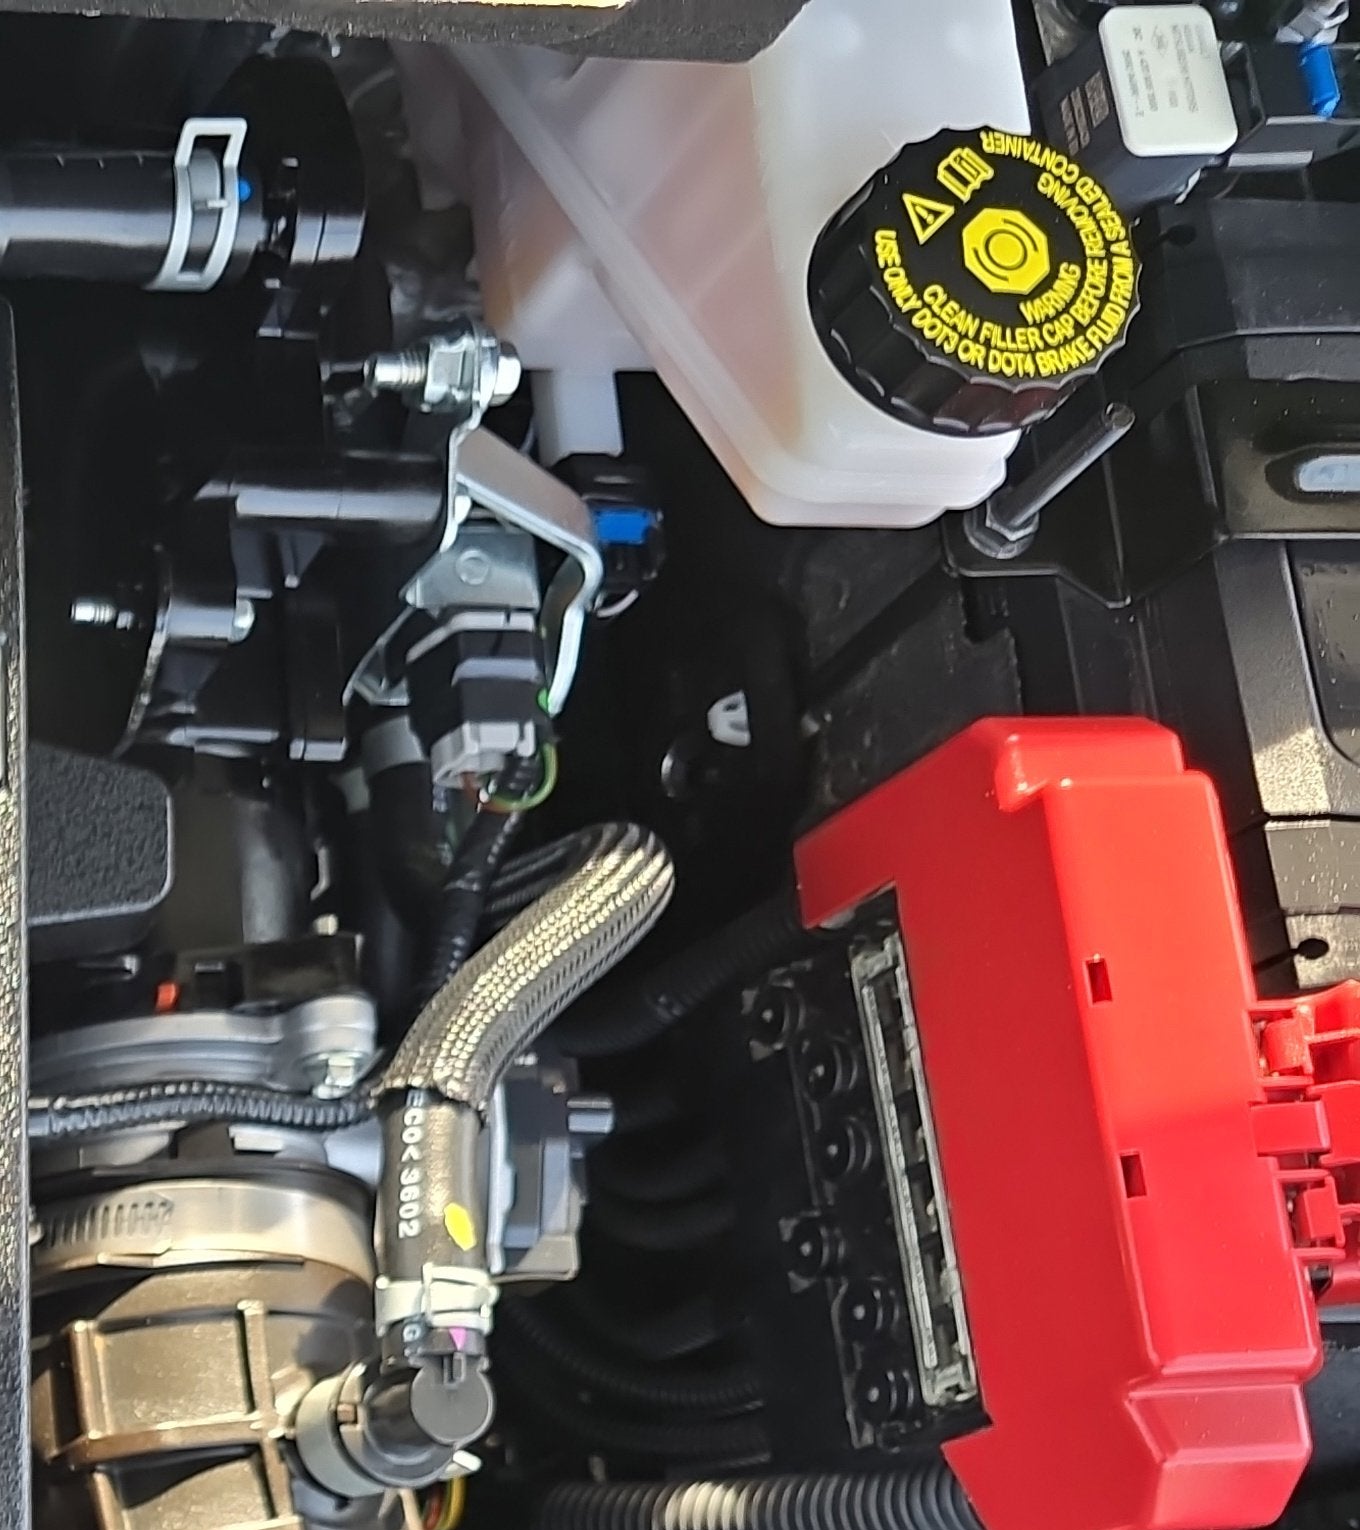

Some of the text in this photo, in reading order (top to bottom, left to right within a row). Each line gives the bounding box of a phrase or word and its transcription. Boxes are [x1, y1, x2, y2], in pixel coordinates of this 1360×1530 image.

[874, 130, 1135, 378] USE ONLY DOT3 OR DOT4 BRAKE FLUID FROM A SEALED CONTAINER
[923, 172, 1108, 352] CLEAN FILLER CAP BEFORE REMOVING
[1019, 261, 1081, 326] WARNING
